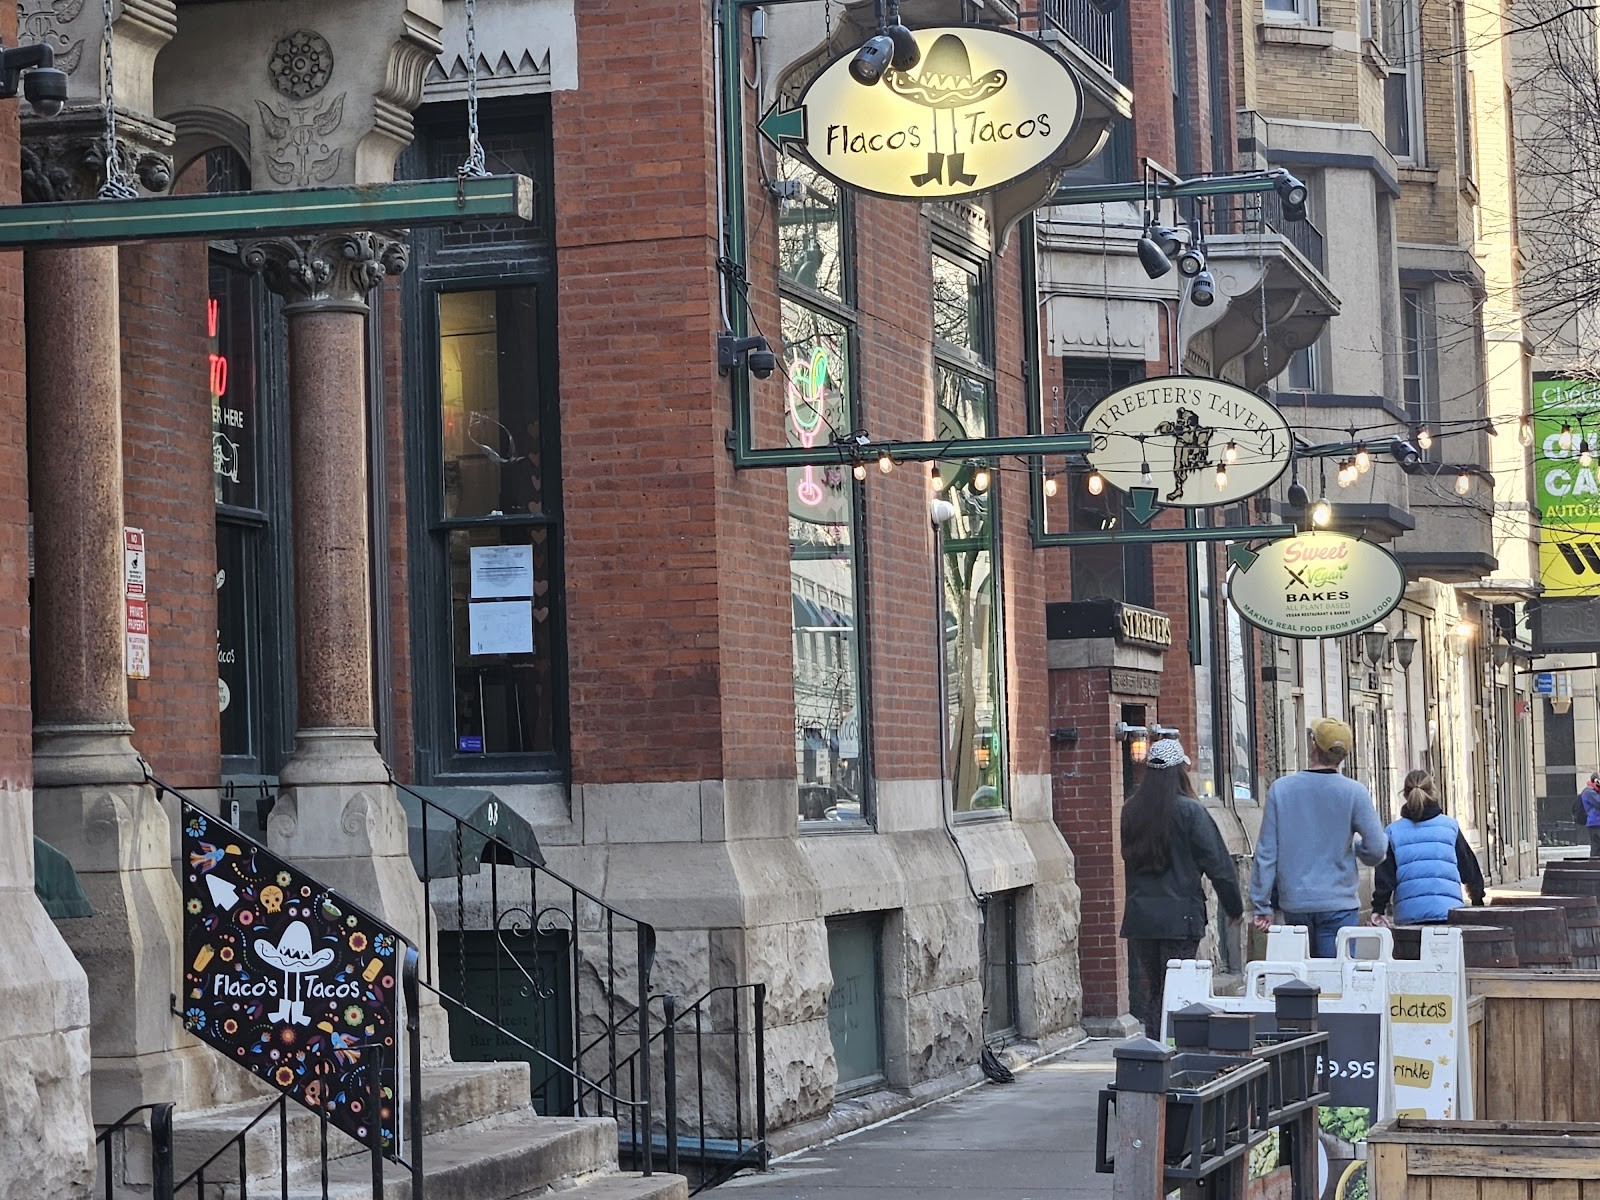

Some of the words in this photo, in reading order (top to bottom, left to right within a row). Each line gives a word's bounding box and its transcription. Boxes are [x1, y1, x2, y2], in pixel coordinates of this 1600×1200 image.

[826, 124, 921, 155] Flacos
[964, 110, 1051, 145] Tacos
[223, 407, 244, 429] HERE
[1208, 392, 1287, 460] TAVERN
[1546, 503, 1587, 518] AUTO
[1283, 540, 1349, 564] Sweet
[1306, 564, 1346, 588] Vegan
[1285, 603, 1299, 611] ALL
[1300, 603, 1324, 611] PLANT
[1325, 602, 1351, 610] BASED
[1286, 591, 1350, 603] BAKES
[1242, 603, 1274, 627] MAKING
[1275, 621, 1298, 632] REAL
[1325, 620, 1349, 631] FROM
[1350, 612, 1373, 626] REAL
[1372, 595, 1393, 616] FOOD
[213, 973, 278, 997] Flaco's
[304, 974, 360, 998] Tacos
[1390, 996, 1447, 1018] chatas
